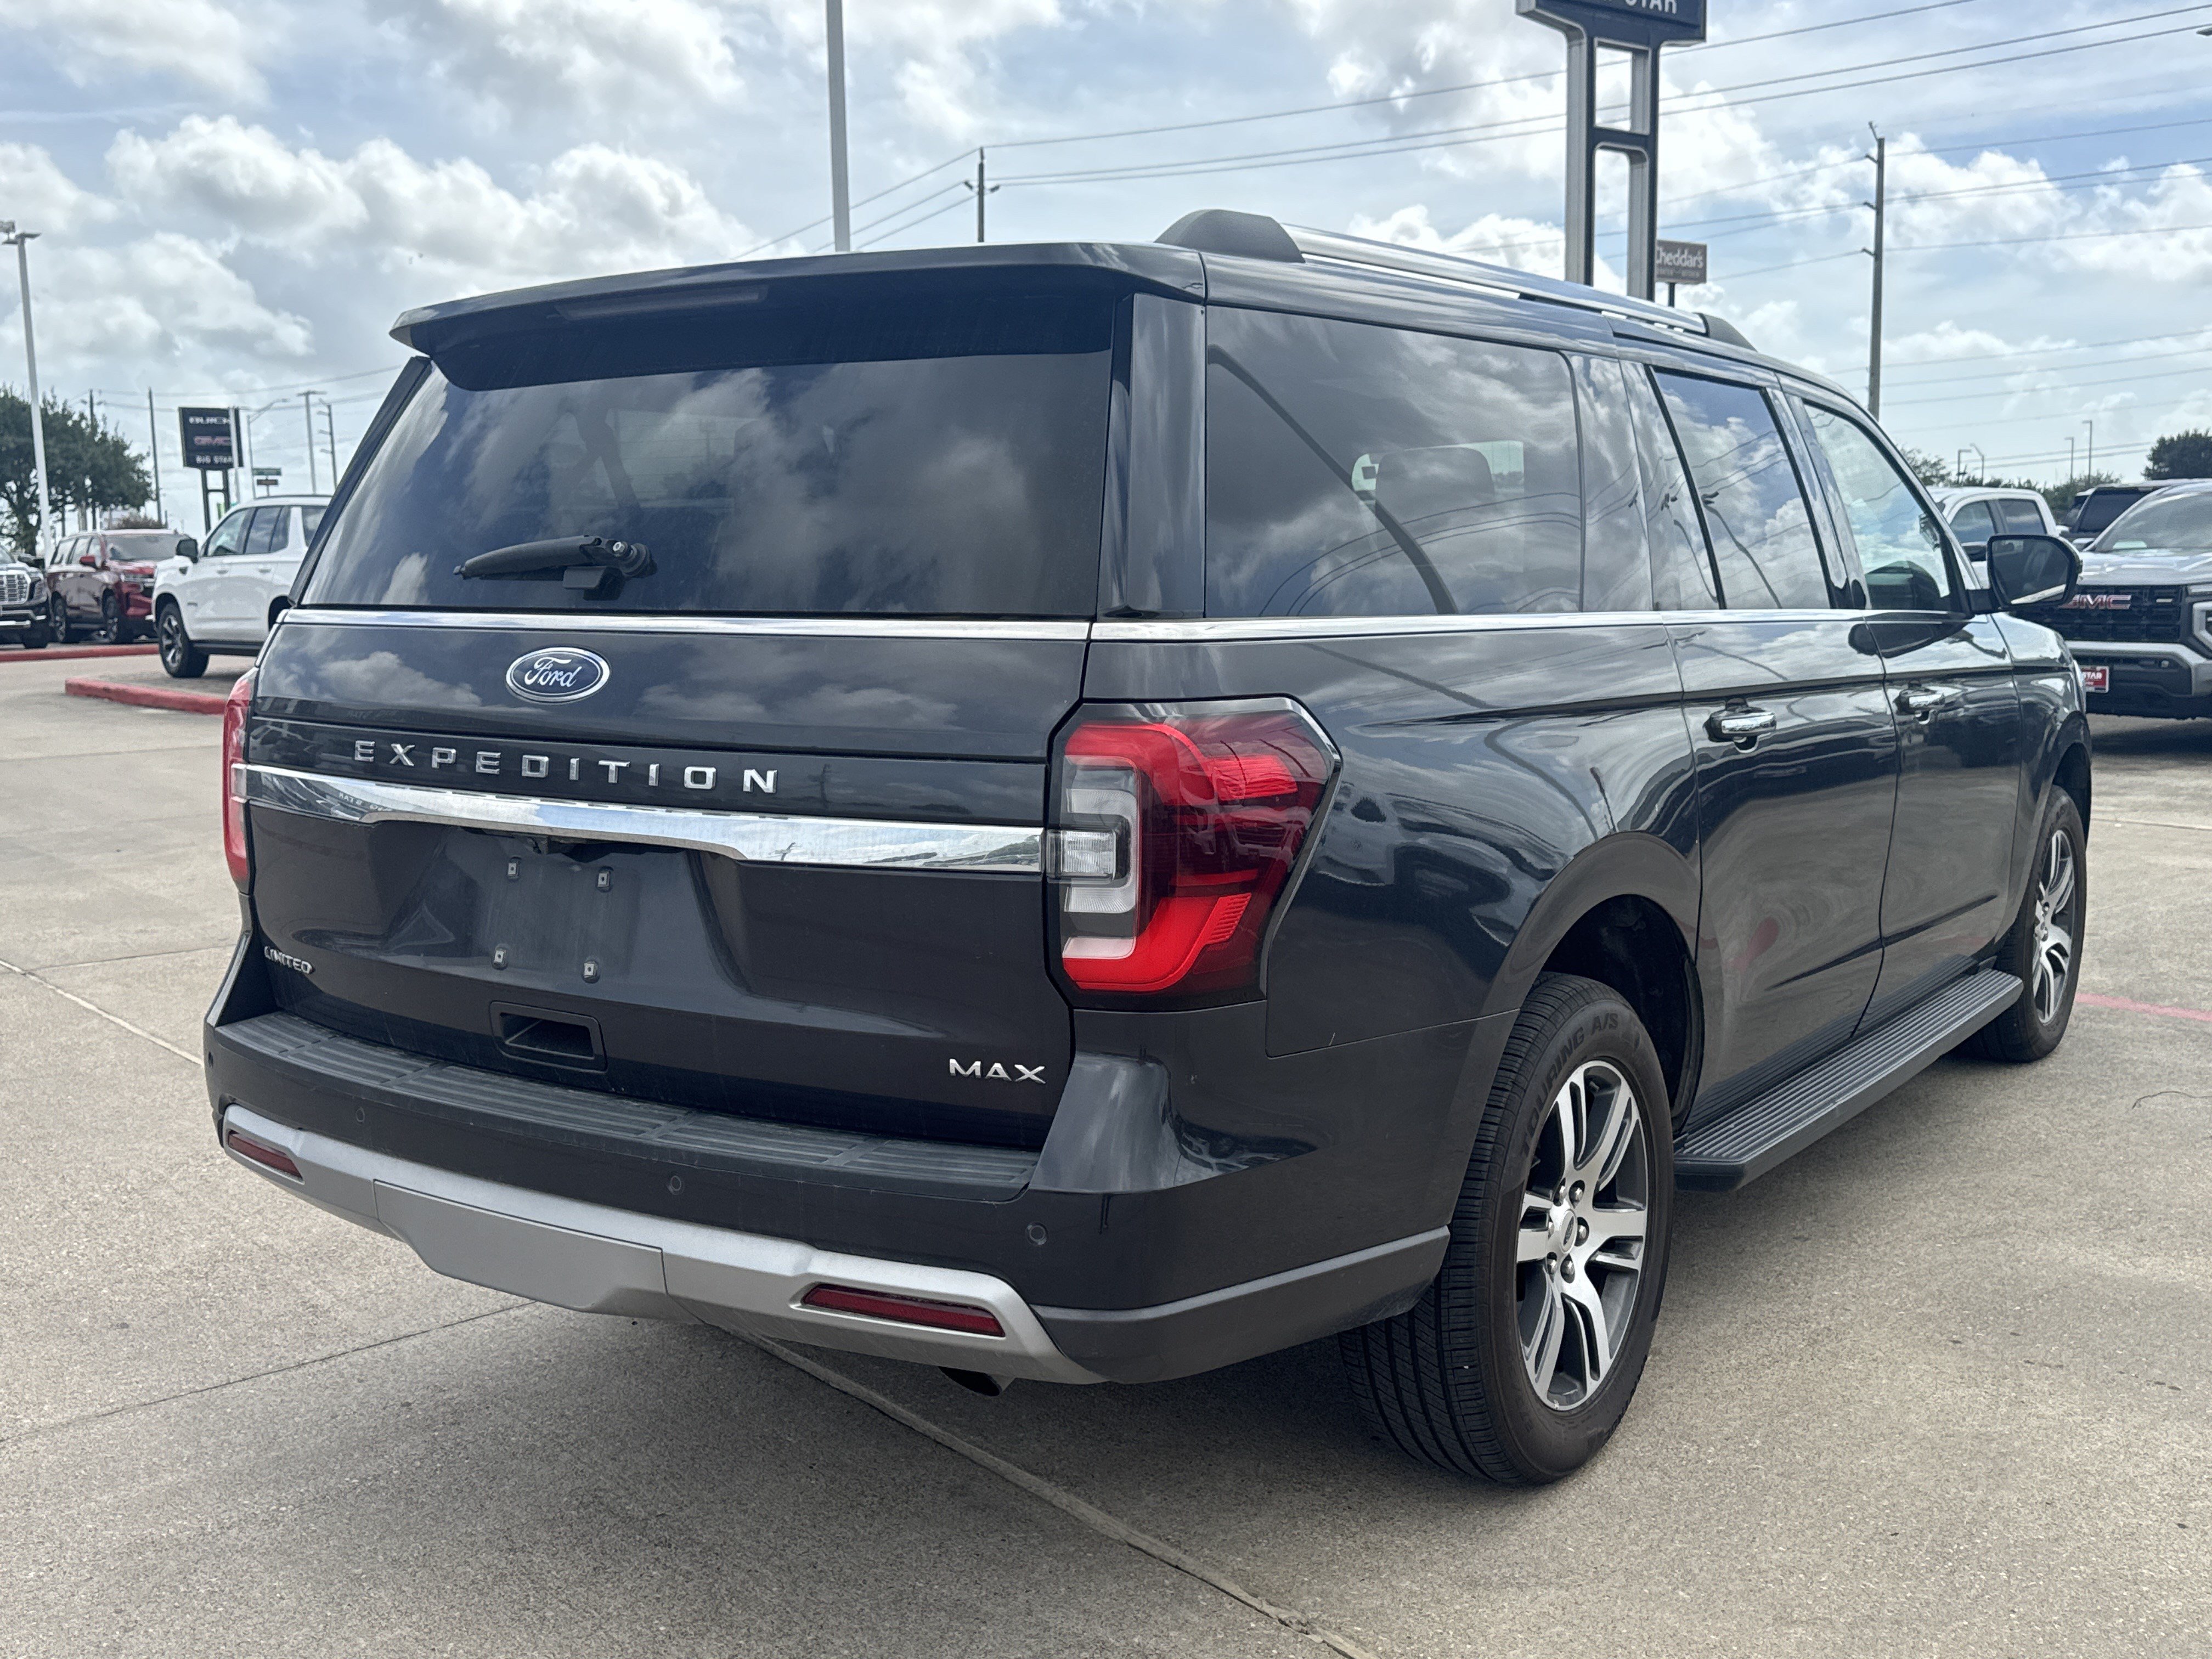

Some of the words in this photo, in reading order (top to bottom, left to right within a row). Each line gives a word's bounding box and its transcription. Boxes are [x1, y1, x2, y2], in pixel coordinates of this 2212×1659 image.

[524, 657, 582, 688] Ford
[353, 740, 778, 794] EXPEDITION
[264, 946, 313, 974] LIMITED
[949, 1058, 1046, 1085] MAX
